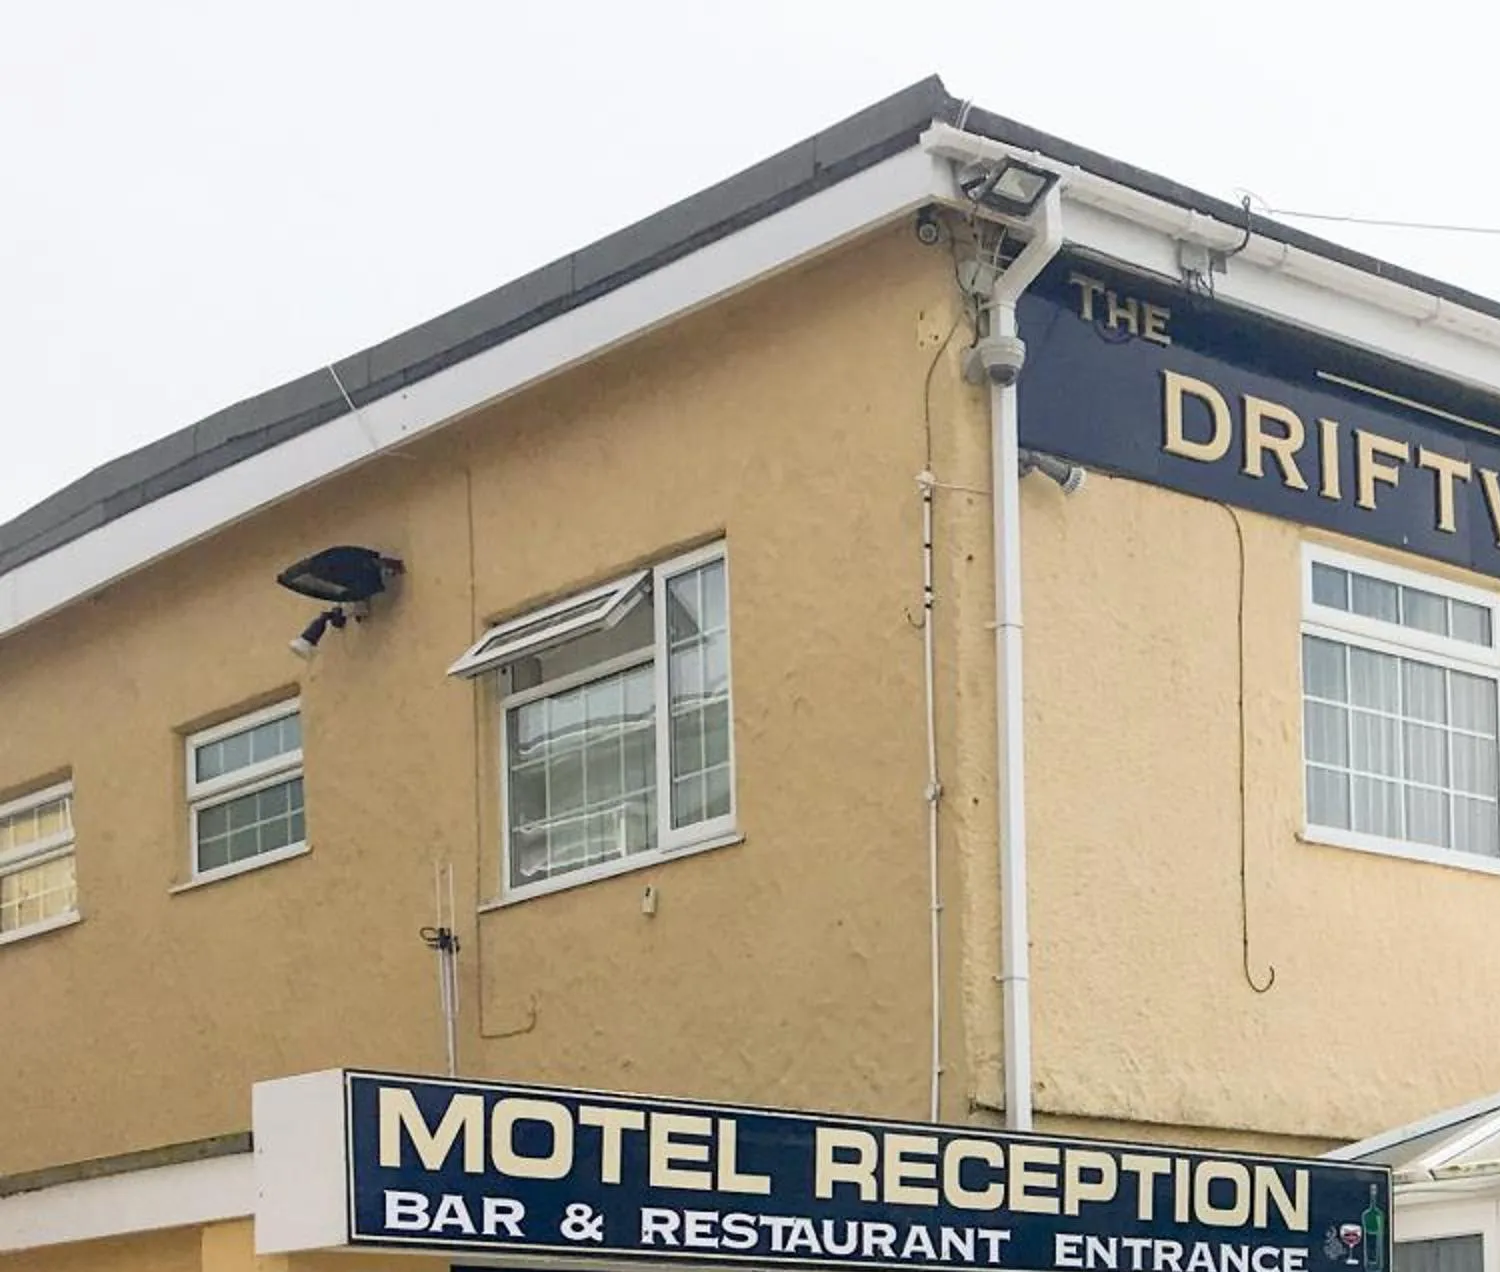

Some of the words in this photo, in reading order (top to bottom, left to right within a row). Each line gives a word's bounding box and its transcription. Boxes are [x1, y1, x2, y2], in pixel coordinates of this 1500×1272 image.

[1069, 274, 1171, 347] THE
[379, 1087, 771, 1195] MOTEL
[815, 1126, 1309, 1232] RECEPTION
[384, 1189, 525, 1237] BAR
[560, 1203, 603, 1241] &
[641, 1207, 1010, 1263] RESTAURANT
